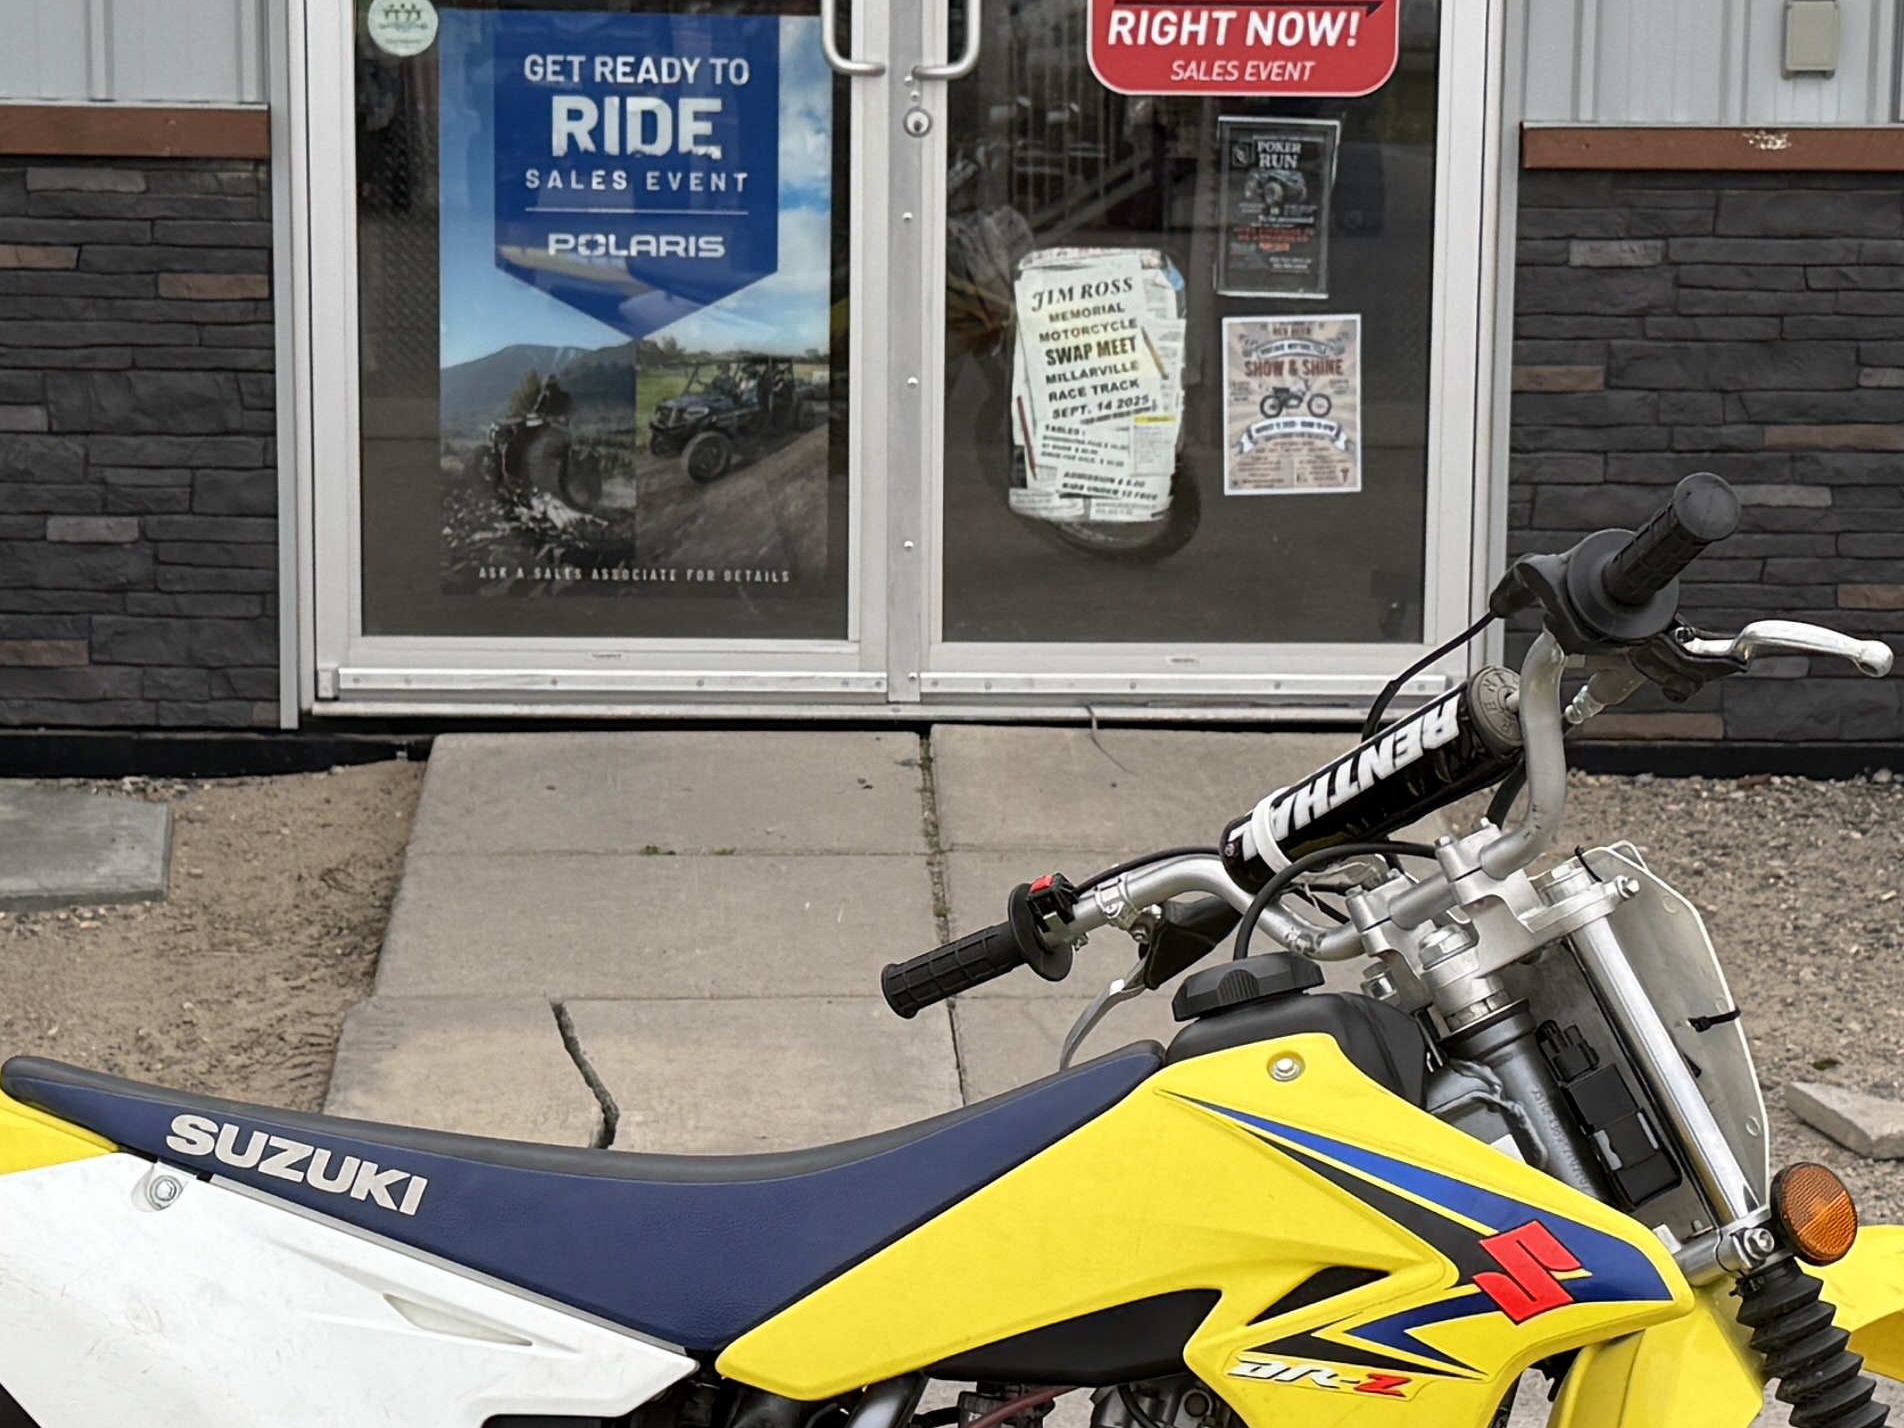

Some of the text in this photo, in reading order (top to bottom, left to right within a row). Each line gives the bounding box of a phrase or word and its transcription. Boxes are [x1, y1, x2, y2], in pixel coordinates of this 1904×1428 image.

[1108, 10, 1360, 47] RIGHT NOW!
[524, 54, 750, 85] GET READY TO
[1171, 60, 1316, 81] SALES EVENT
[551, 95, 723, 160] RIDE
[1257, 141, 1301, 153] POKER
[1259, 154, 1297, 169] RUN
[525, 169, 748, 193] SALES EVENT
[547, 233, 726, 258] POLARIS
[1031, 277, 1133, 312] JIM ROSS
[1048, 302, 1125, 323] MEMORIAL
[1039, 317, 1138, 342] MOTORCYCLE
[1045, 335, 1136, 366] SWAP MEET
[1045, 360, 1139, 385] MILLARVILLE
[1244, 359, 1344, 377] SHOW & SHINE
[1048, 378, 1139, 402] RACE TRACK
[1052, 404, 1091, 420] SEPT.
[1097, 401, 1112, 411] 14
[1116, 394, 1149, 410] 2025
[534, 567, 582, 580] SALES
[592, 568, 677, 581] ASSOCIATE
[687, 569, 715, 582] FOR
[724, 569, 790, 583] DETAILS
[165, 1113, 429, 1217] SUZUKI
[1229, 1359, 1413, 1398] DR-Z
